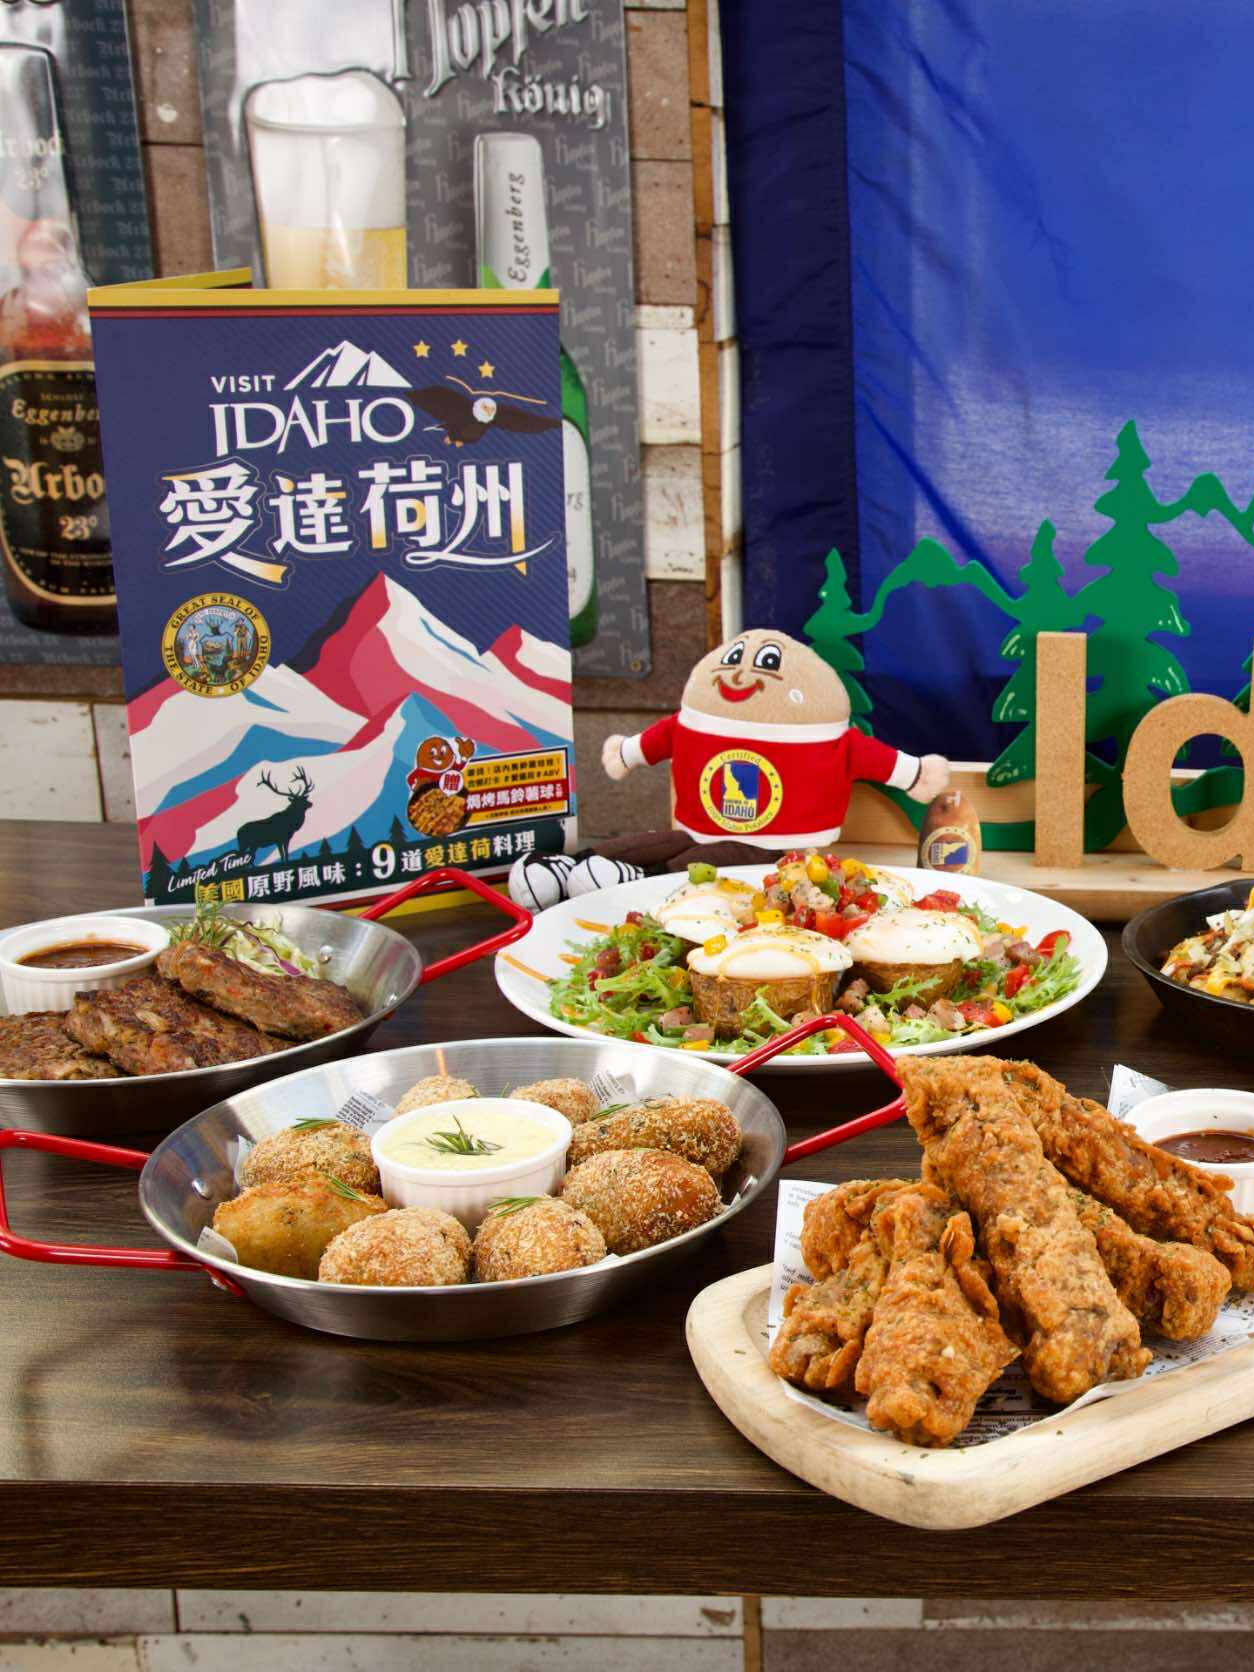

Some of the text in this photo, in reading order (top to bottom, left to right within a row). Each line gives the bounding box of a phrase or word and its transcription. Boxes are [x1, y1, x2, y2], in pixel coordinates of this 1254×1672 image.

[493, 66, 611, 129] König
[507, 172, 531, 283] Eggenberg
[210, 375, 276, 393] VISIT
[12, 398, 100, 425] Eggenbe
[208, 395, 415, 457] IDAHO
[58, 514, 98, 541] 23°
[159, 459, 553, 585] 愛達荷州
[171, 598, 206, 628] GREAT
[211, 597, 242, 607] SEAL
[244, 606, 261, 620] OF
[164, 646, 178, 669] THE
[249, 635, 269, 678] IDAHO
[176, 672, 214, 694] STATE
[230, 678, 247, 692] OF
[724, 803, 756, 818] IDAHO
[167, 853, 253, 893] Limited Time
